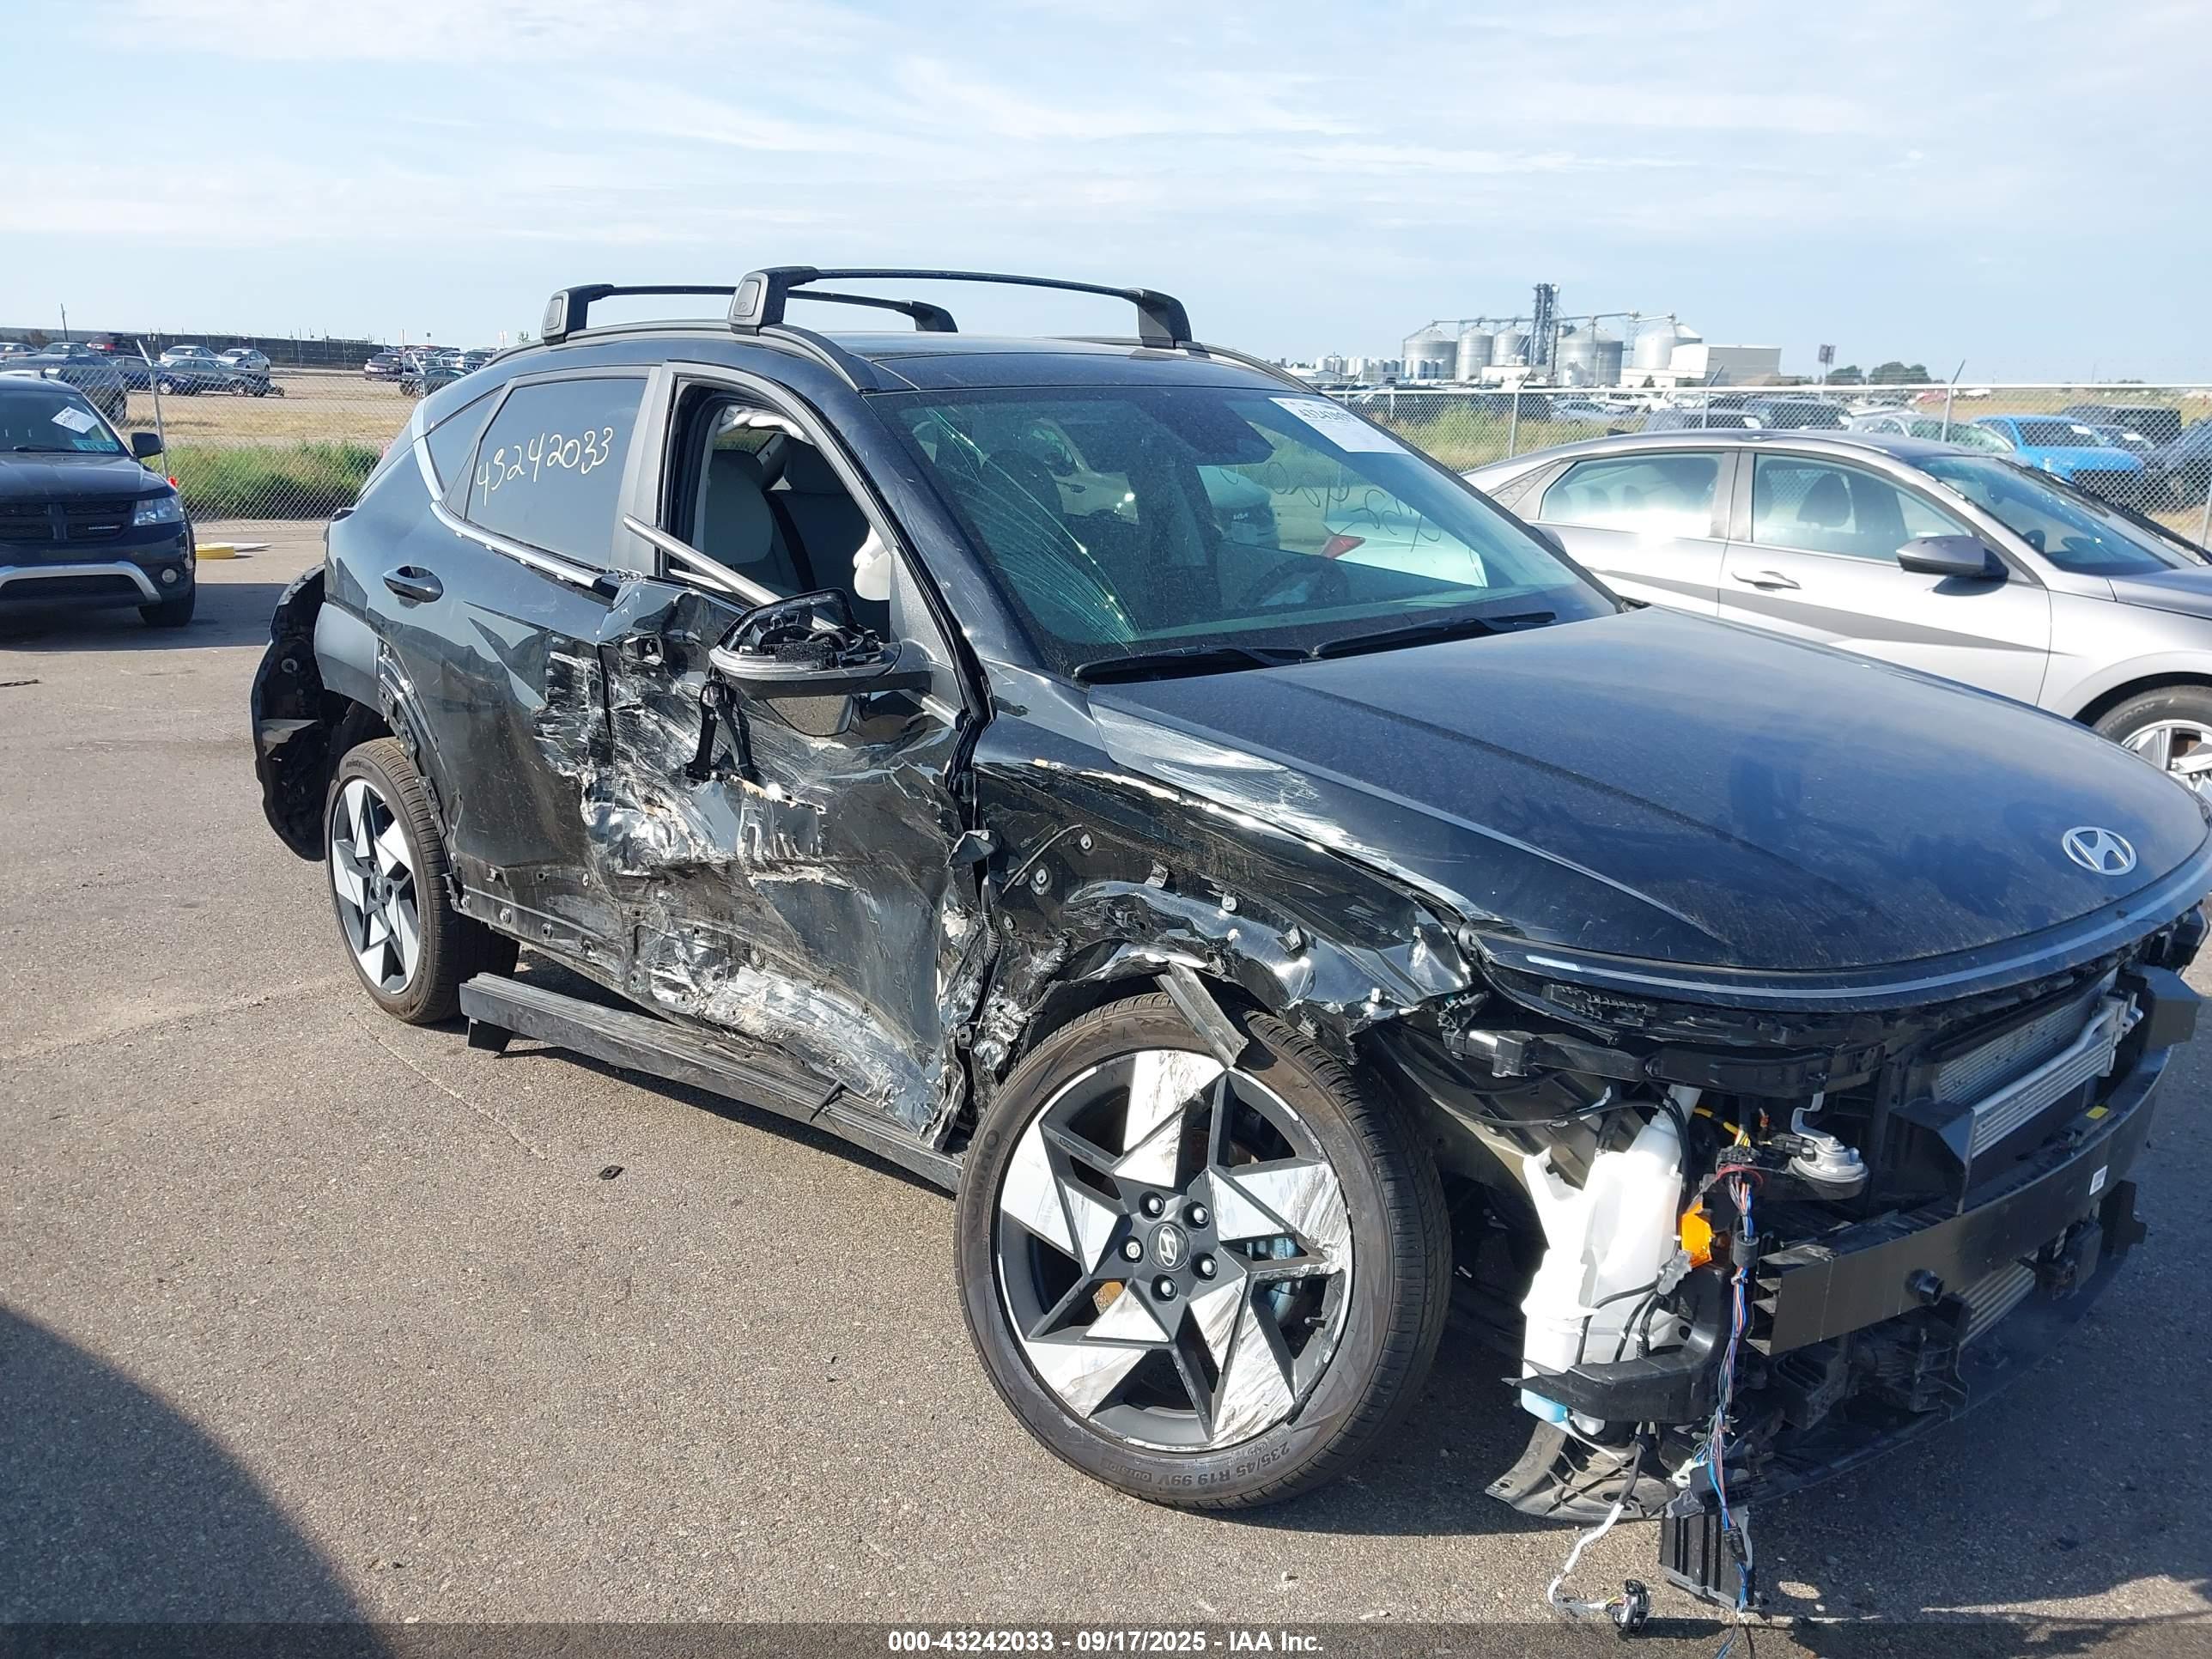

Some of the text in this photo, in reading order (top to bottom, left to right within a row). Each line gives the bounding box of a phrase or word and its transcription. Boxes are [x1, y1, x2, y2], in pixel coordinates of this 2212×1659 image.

[477, 427, 613, 507] 43242033
[963, 1129, 1000, 1243] KUMHO
[1236, 1441, 1291, 1477] 235/45
[1159, 1474, 1193, 1486] 99V
[1198, 1469, 1231, 1486] R19
